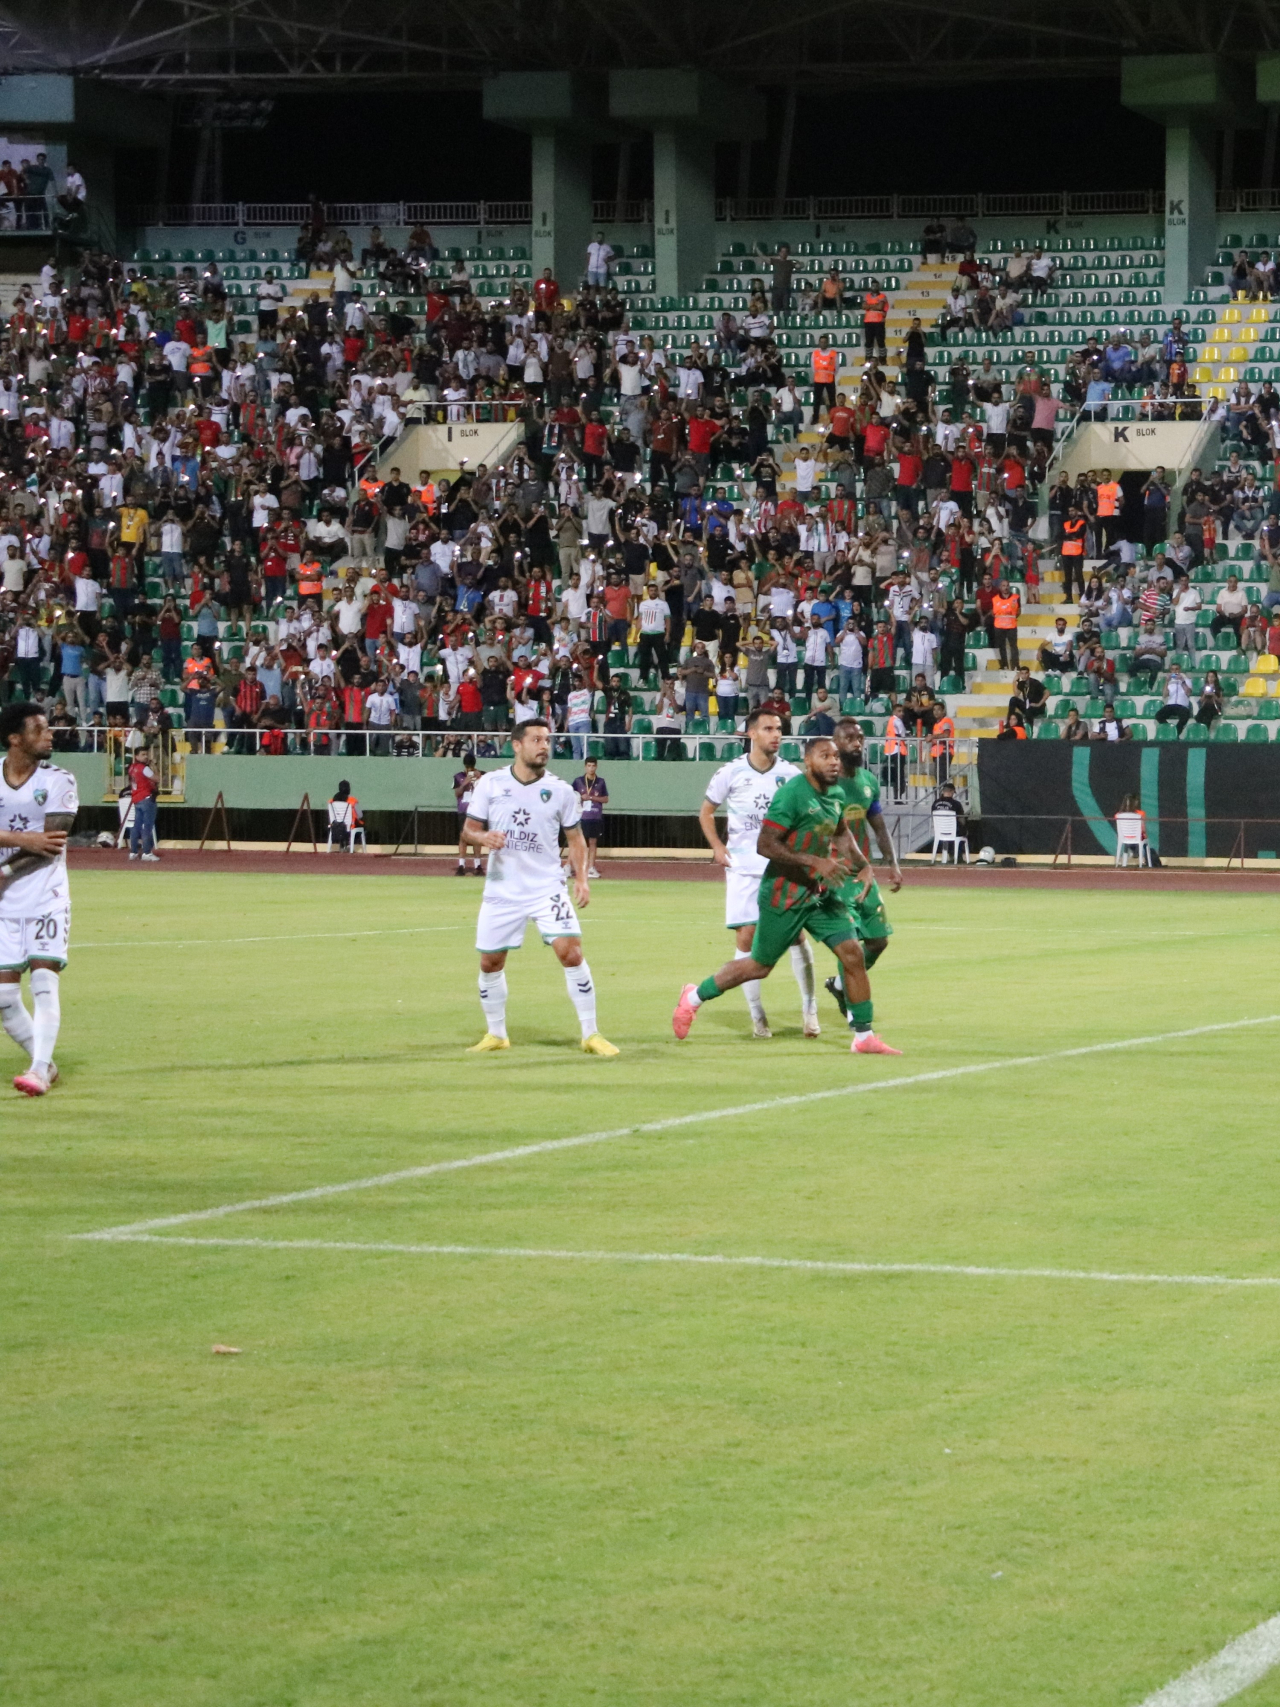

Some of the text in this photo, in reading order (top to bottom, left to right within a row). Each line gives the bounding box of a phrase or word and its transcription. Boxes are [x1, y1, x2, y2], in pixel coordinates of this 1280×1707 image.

[1169, 199, 1184, 216] K
[1046, 219, 1084, 235] K BLOK
[1167, 218, 1187, 226] BLOK
[234, 231, 247, 245] G
[534, 229, 552, 238] BLOK
[656, 227, 675, 236] BLOK
[447, 426, 479, 442] I BLOK
[1113, 426, 1157, 443] K BLOK
[503, 828, 539, 844] YILDIZ
[504, 839, 545, 854] NTEGRE
[551, 901, 573, 922] 22
[35, 917, 58, 940] 20
